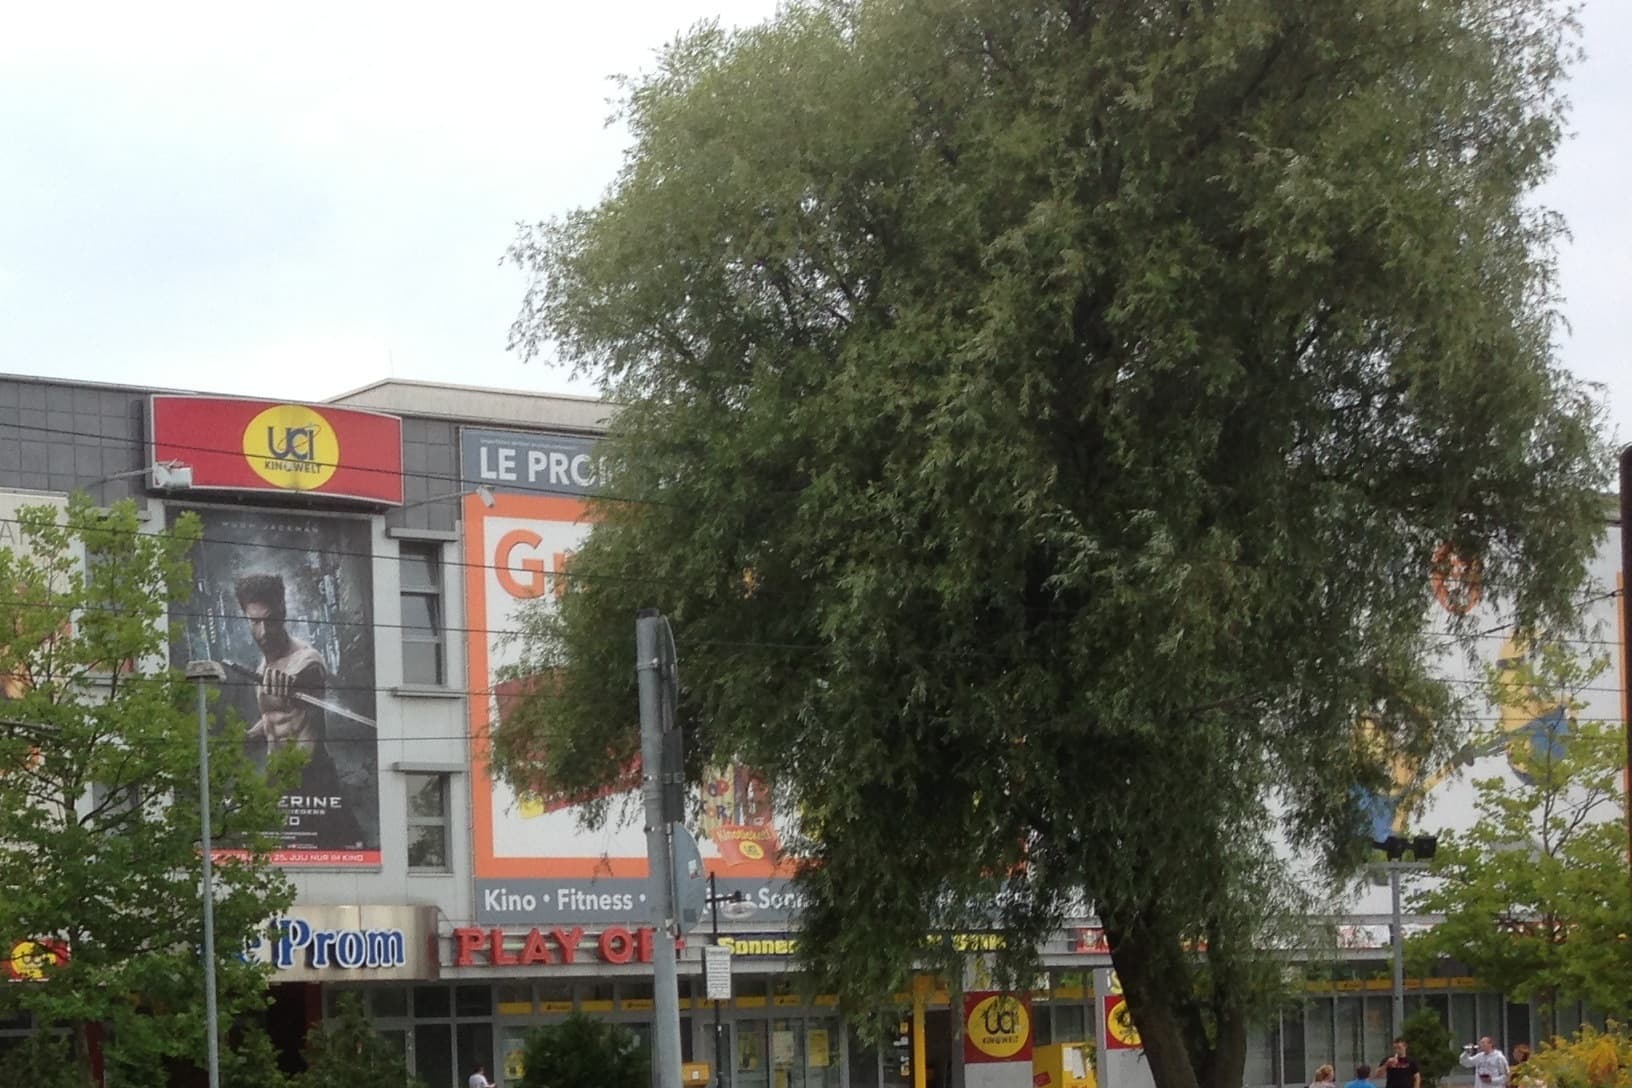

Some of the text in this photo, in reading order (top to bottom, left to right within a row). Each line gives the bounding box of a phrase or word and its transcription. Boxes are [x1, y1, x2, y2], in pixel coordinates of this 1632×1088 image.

[480, 447, 517, 480] LE
[485, 889, 537, 911] Kino
[557, 888, 633, 911] Fitness
[453, 927, 586, 966] PLAY
